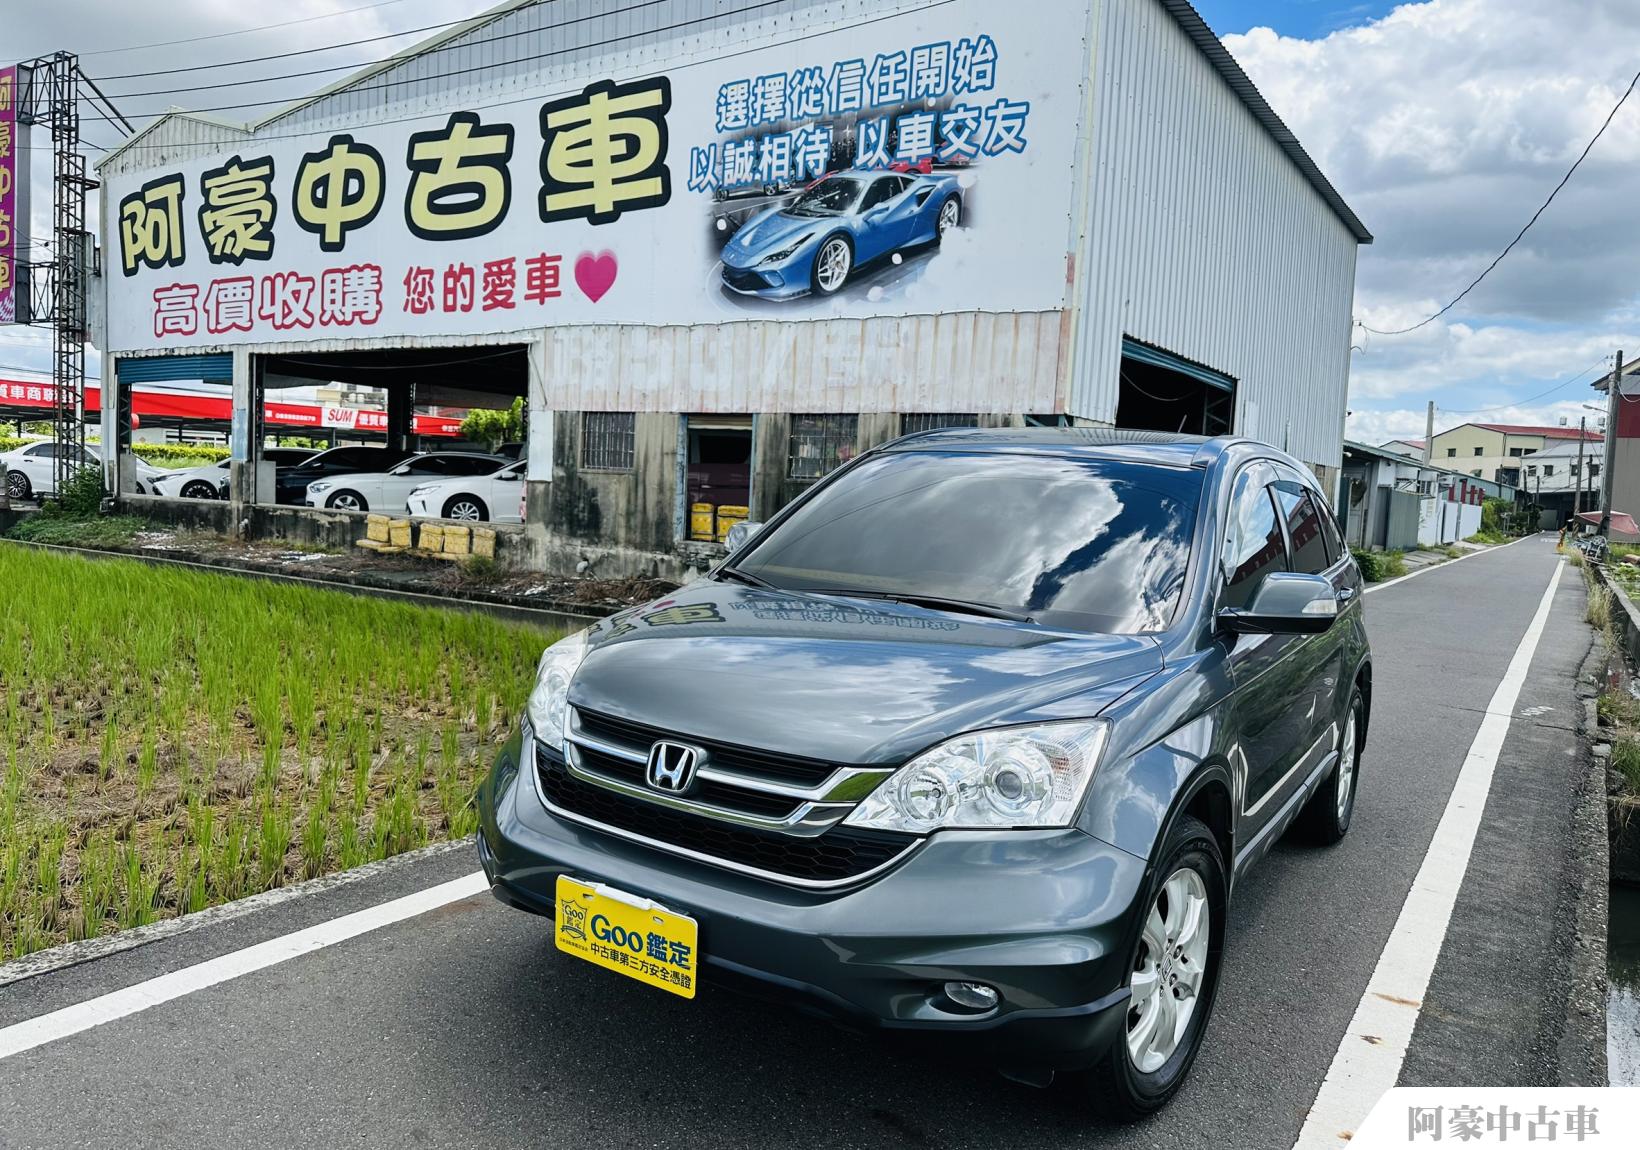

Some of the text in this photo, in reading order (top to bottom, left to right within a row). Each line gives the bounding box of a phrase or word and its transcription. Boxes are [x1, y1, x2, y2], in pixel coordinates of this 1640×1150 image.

[716, 34, 998, 132] 選擇從信任開始
[119, 76, 671, 276] 阿豪中古車
[687, 98, 1029, 191] 以誠相待 以車交友
[154, 252, 563, 337] 高價收購 您的愛車
[327, 408, 353, 423] SUM
[564, 904, 584, 921] Goo
[590, 914, 691, 970] Goo 鑑定
[590, 942, 692, 989] 中古車第三方安全憑證
